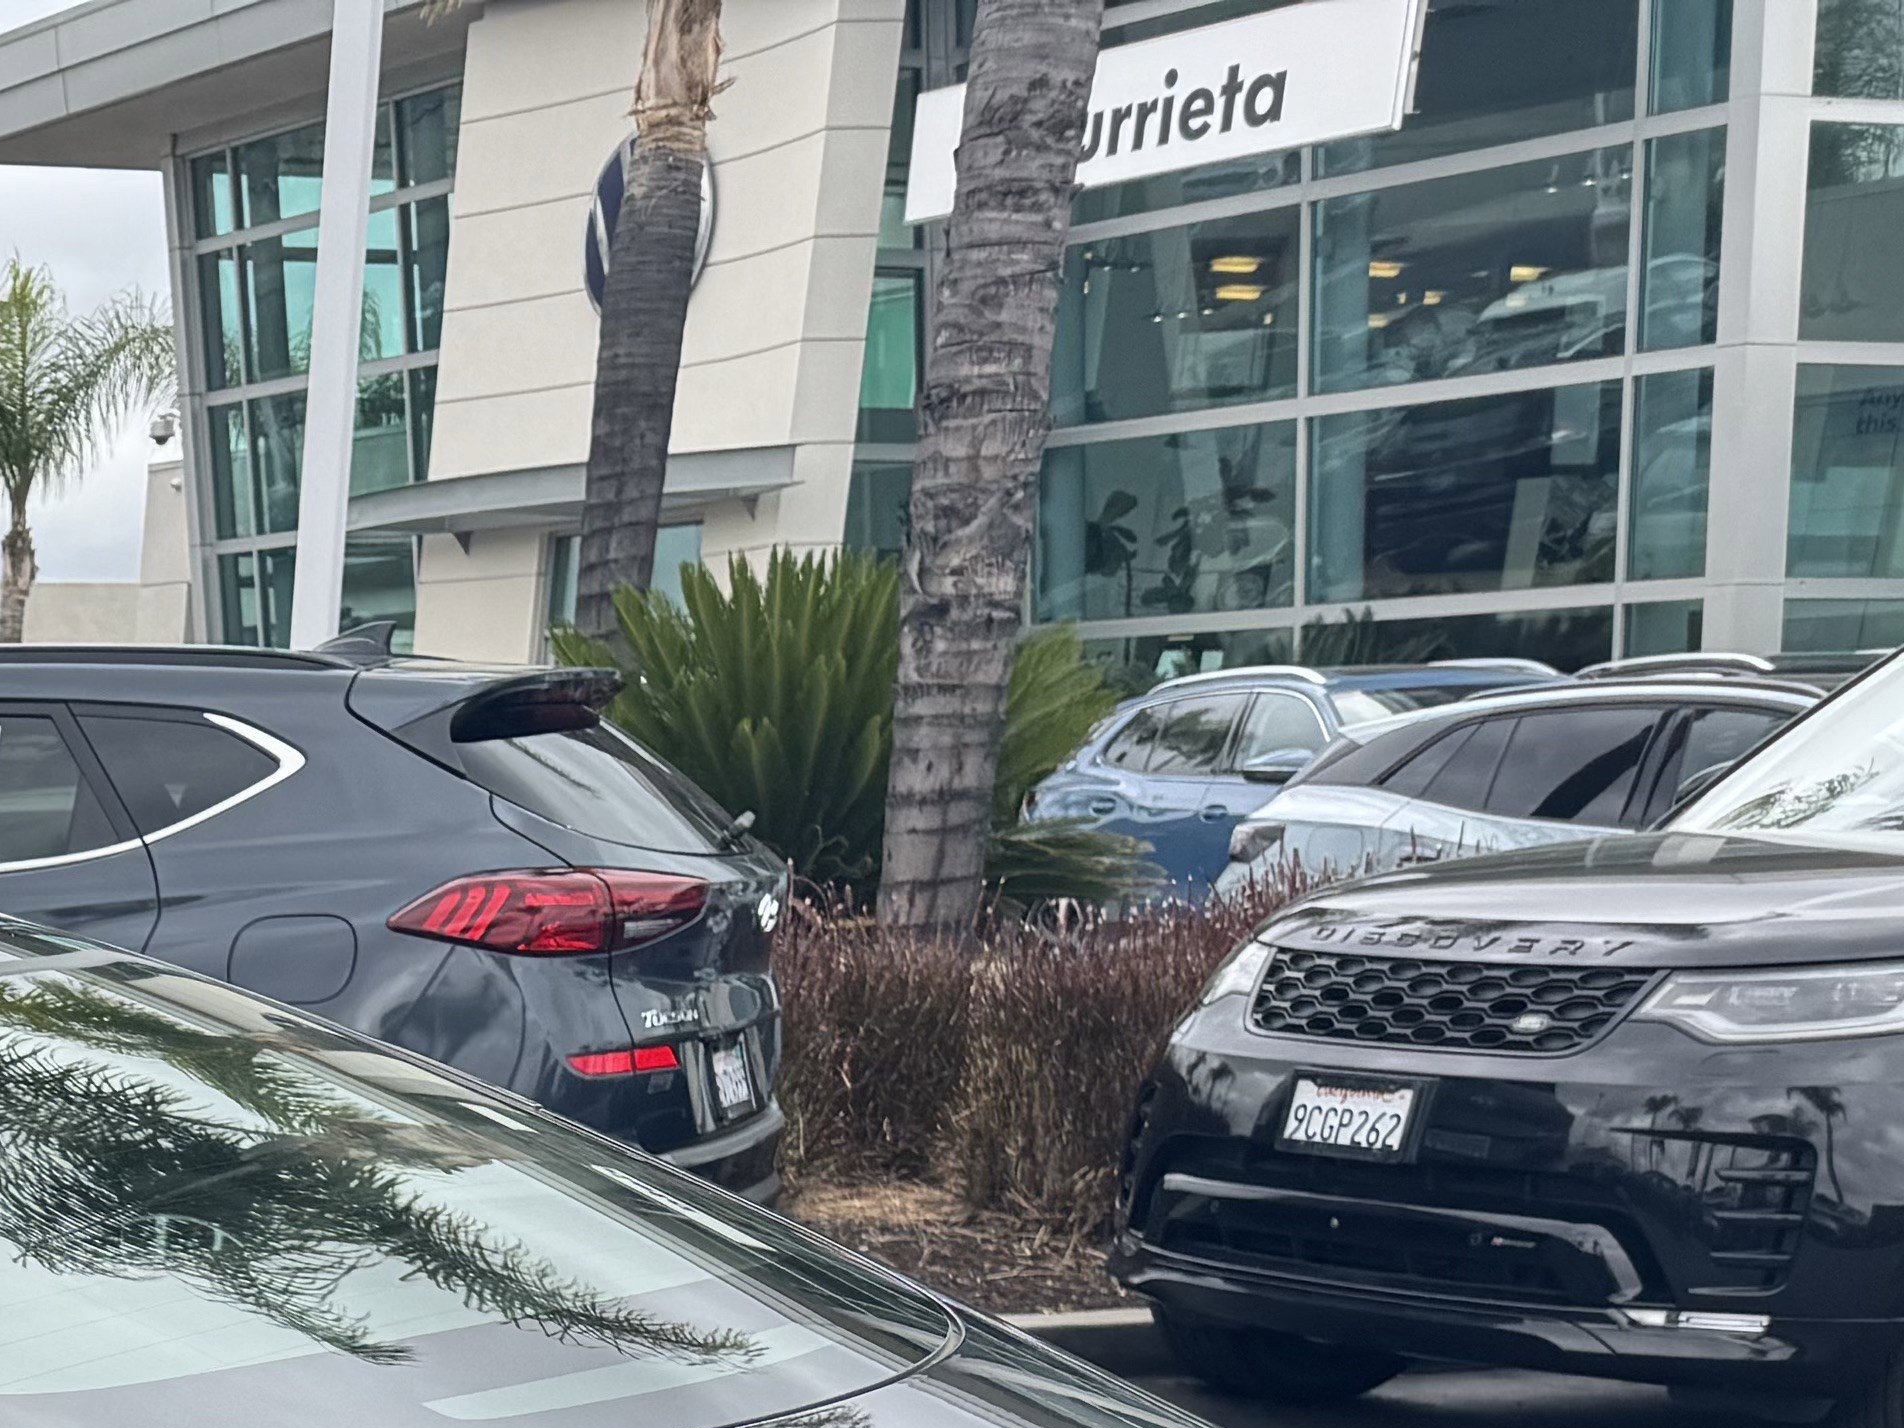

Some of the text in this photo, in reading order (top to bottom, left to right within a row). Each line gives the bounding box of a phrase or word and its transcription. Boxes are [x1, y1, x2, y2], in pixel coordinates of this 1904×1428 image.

[1078, 62, 1287, 162] urrieta
[1310, 926, 1634, 957] DISCOVERY
[1290, 1103, 1402, 1149] 9CGP262
